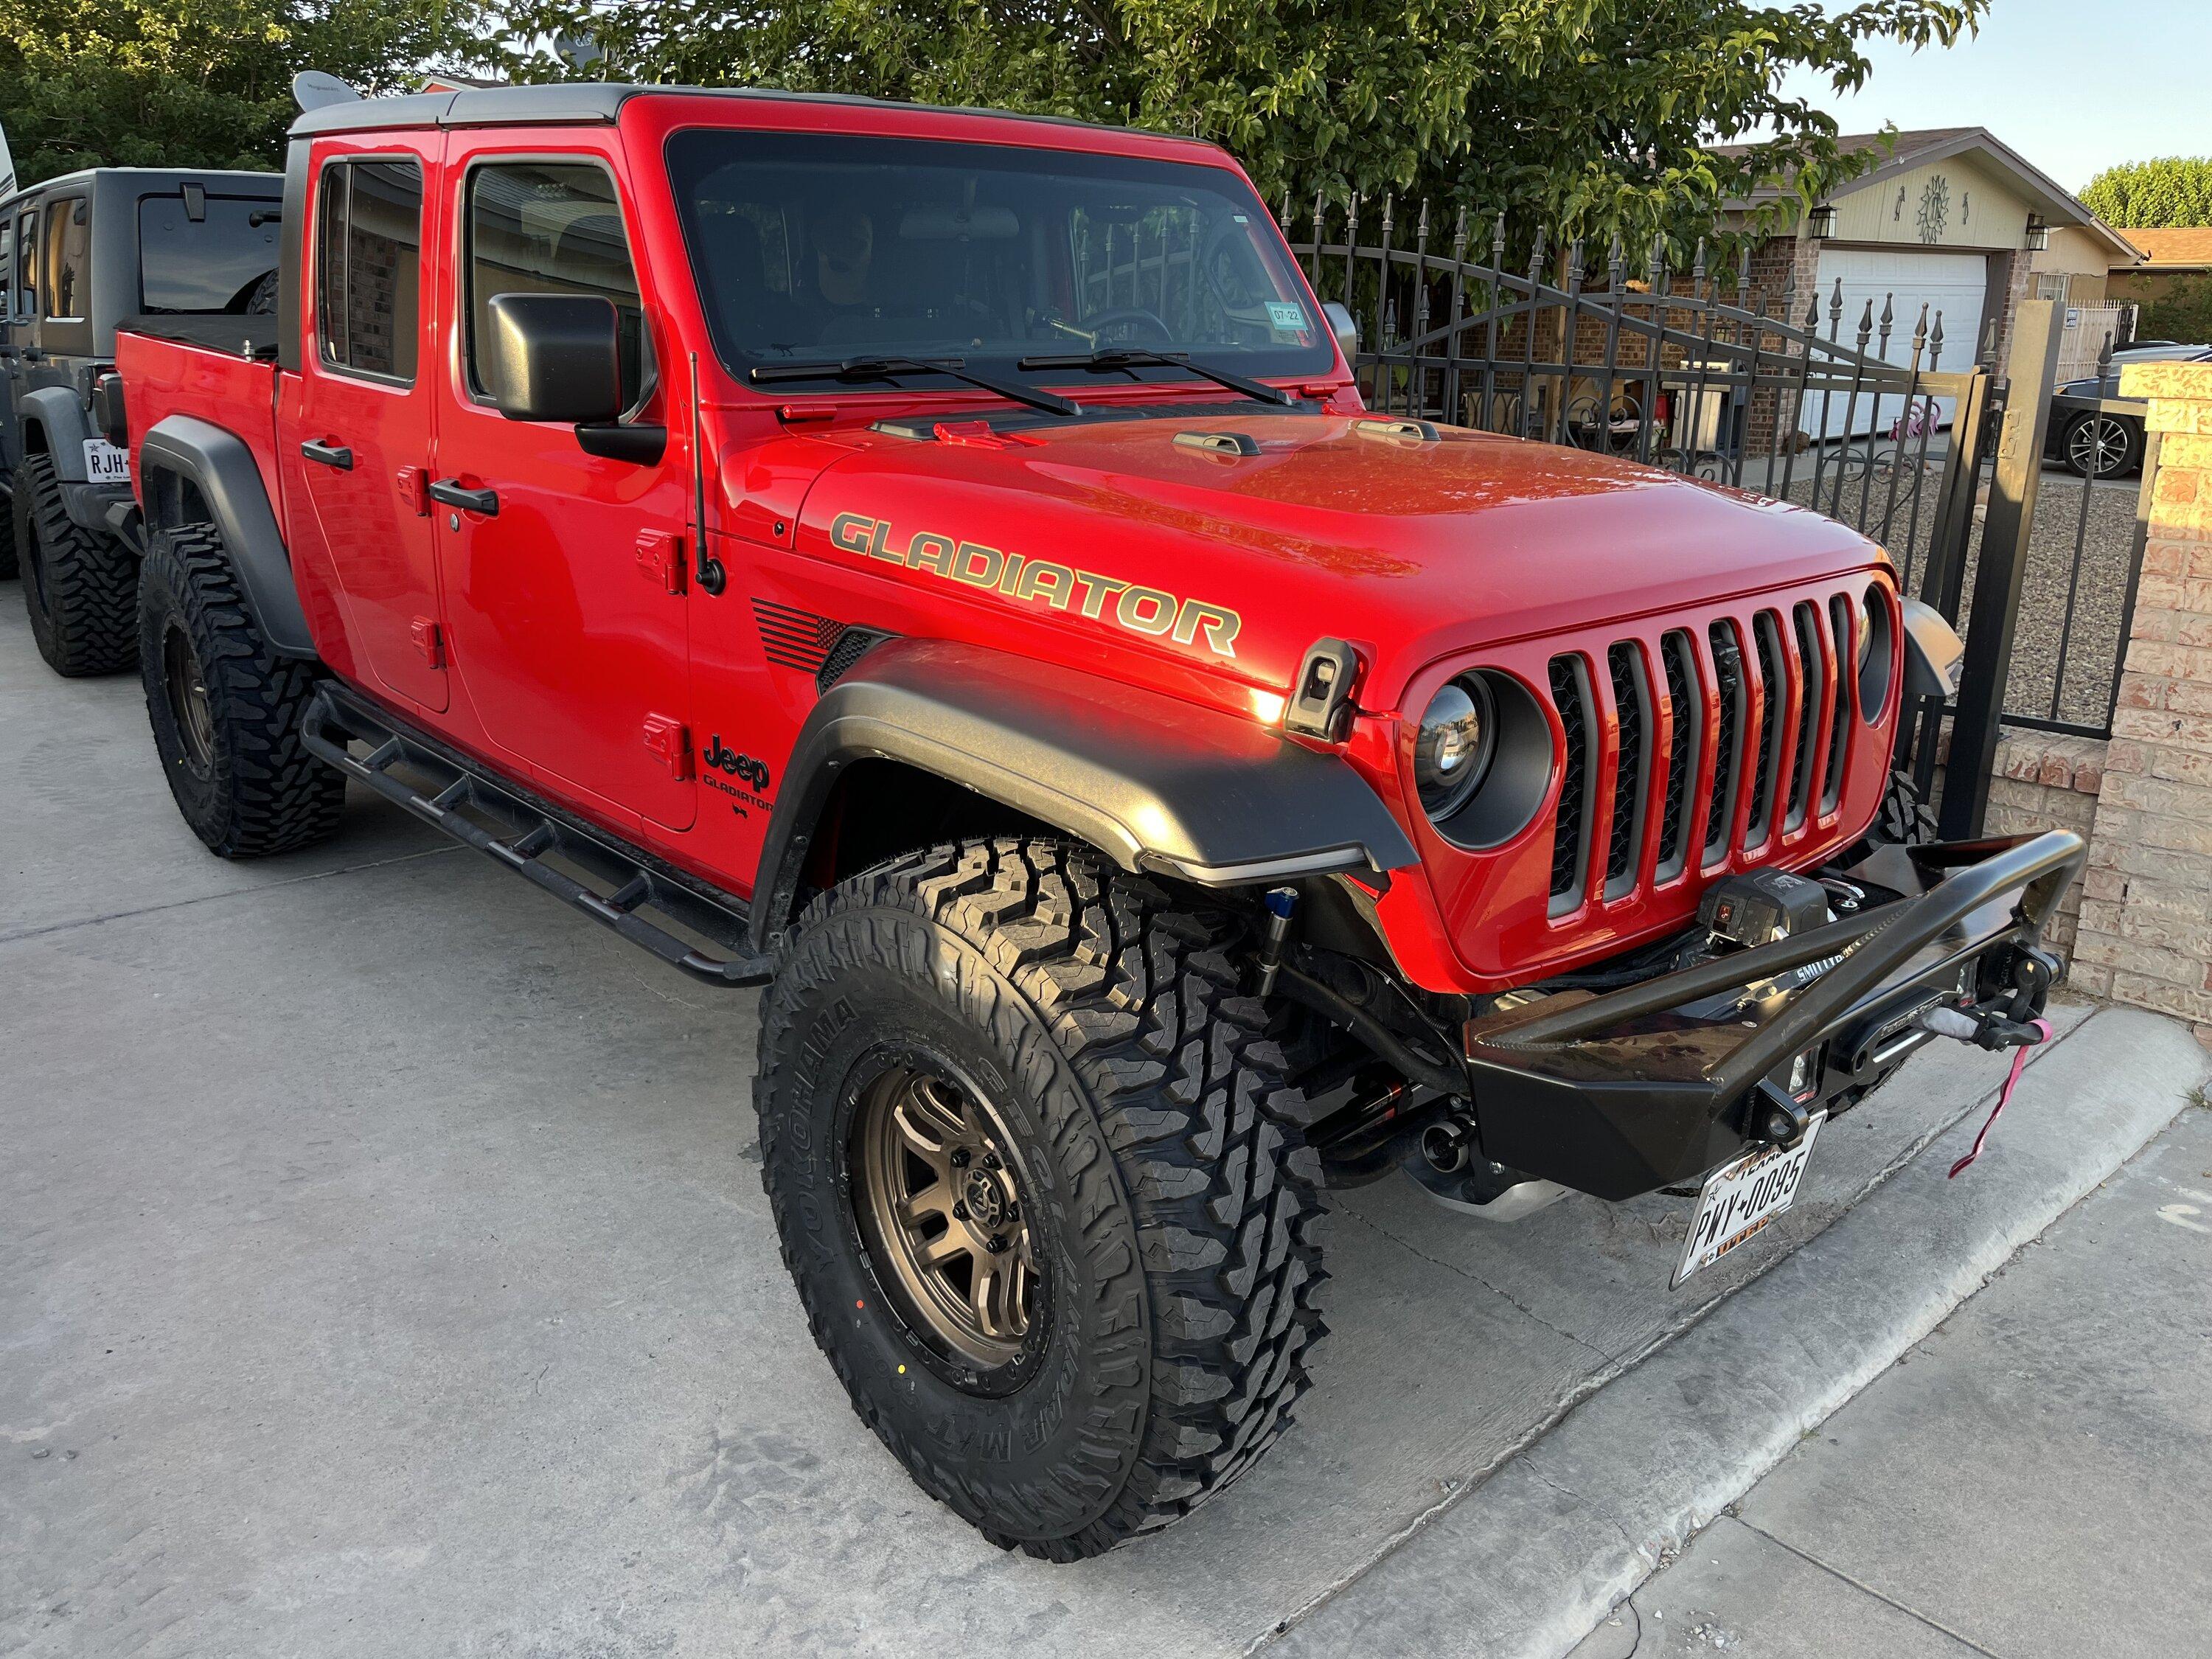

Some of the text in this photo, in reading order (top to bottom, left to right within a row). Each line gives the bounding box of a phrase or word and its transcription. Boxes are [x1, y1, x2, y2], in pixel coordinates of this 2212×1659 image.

[90, 454, 124, 474] RJH
[830, 511, 1242, 658] GLADIATOR
[703, 733, 770, 794] Jeep
[703, 773, 774, 812] GLADIATOR
[789, 993, 860, 1273] YOKOHAMA
[1744, 1150, 1806, 1221] 0095
[1715, 1214, 1770, 1259] UTEP
